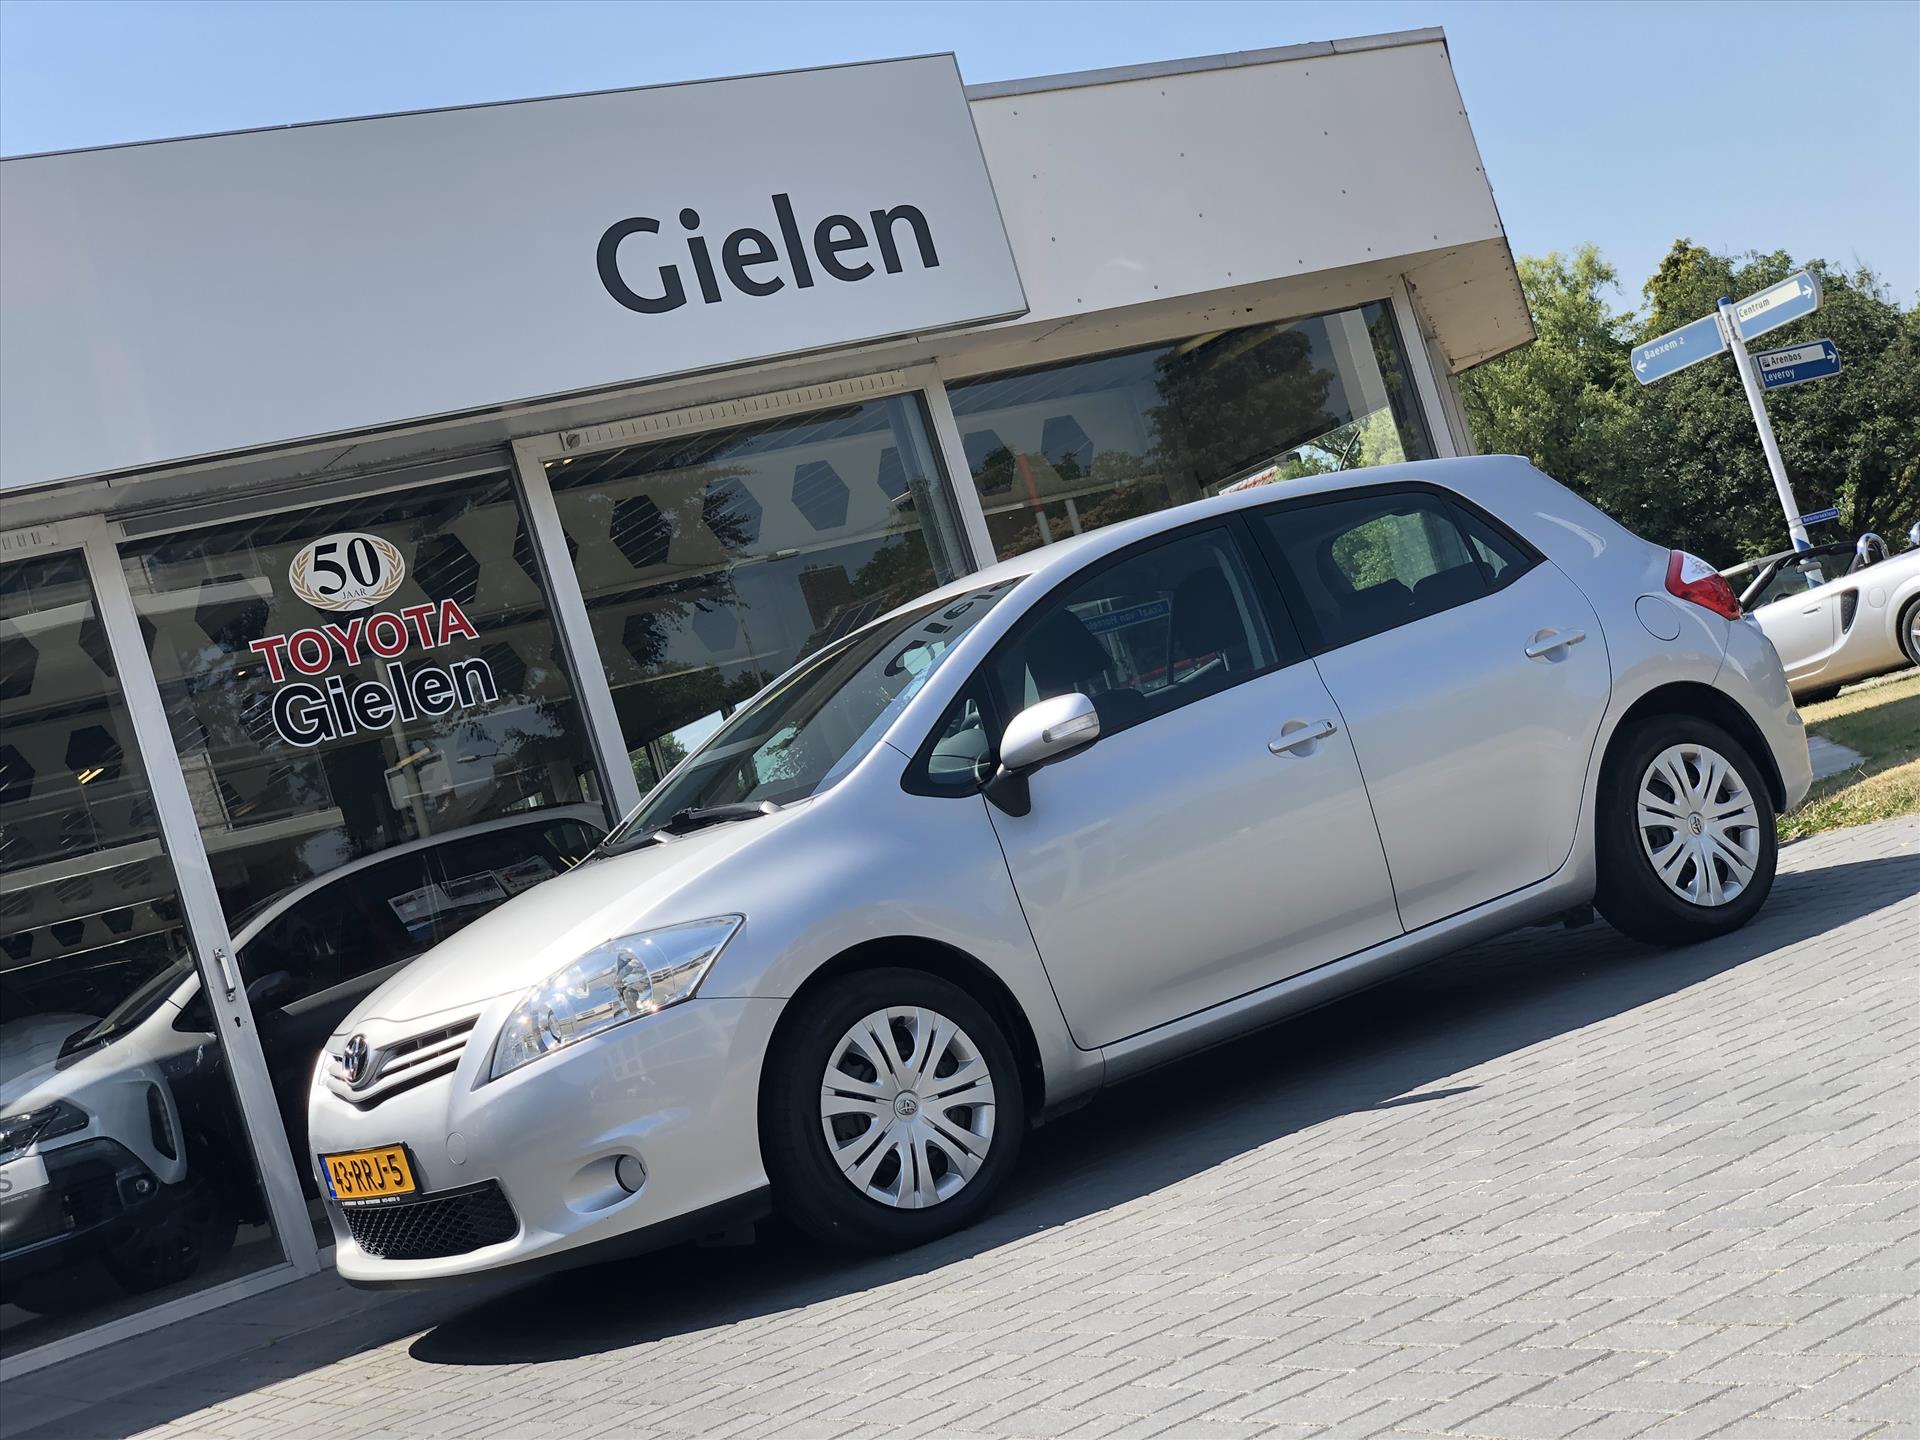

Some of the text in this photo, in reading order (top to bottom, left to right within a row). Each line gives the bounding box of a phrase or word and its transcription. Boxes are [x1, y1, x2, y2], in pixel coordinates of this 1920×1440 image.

[597, 193, 940, 314] Gielen
[1739, 298, 1770, 318] Centrum
[1644, 336, 1686, 360] Baexem 2
[1771, 352, 1802, 366] Arenbos
[1763, 369, 1796, 384] Leveroy
[311, 537, 381, 595] 50
[341, 587, 368, 600] JAAR
[249, 598, 480, 684] TOYOTA
[272, 657, 499, 748] Gielen
[332, 1153, 405, 1194] 43-RRJ-5
